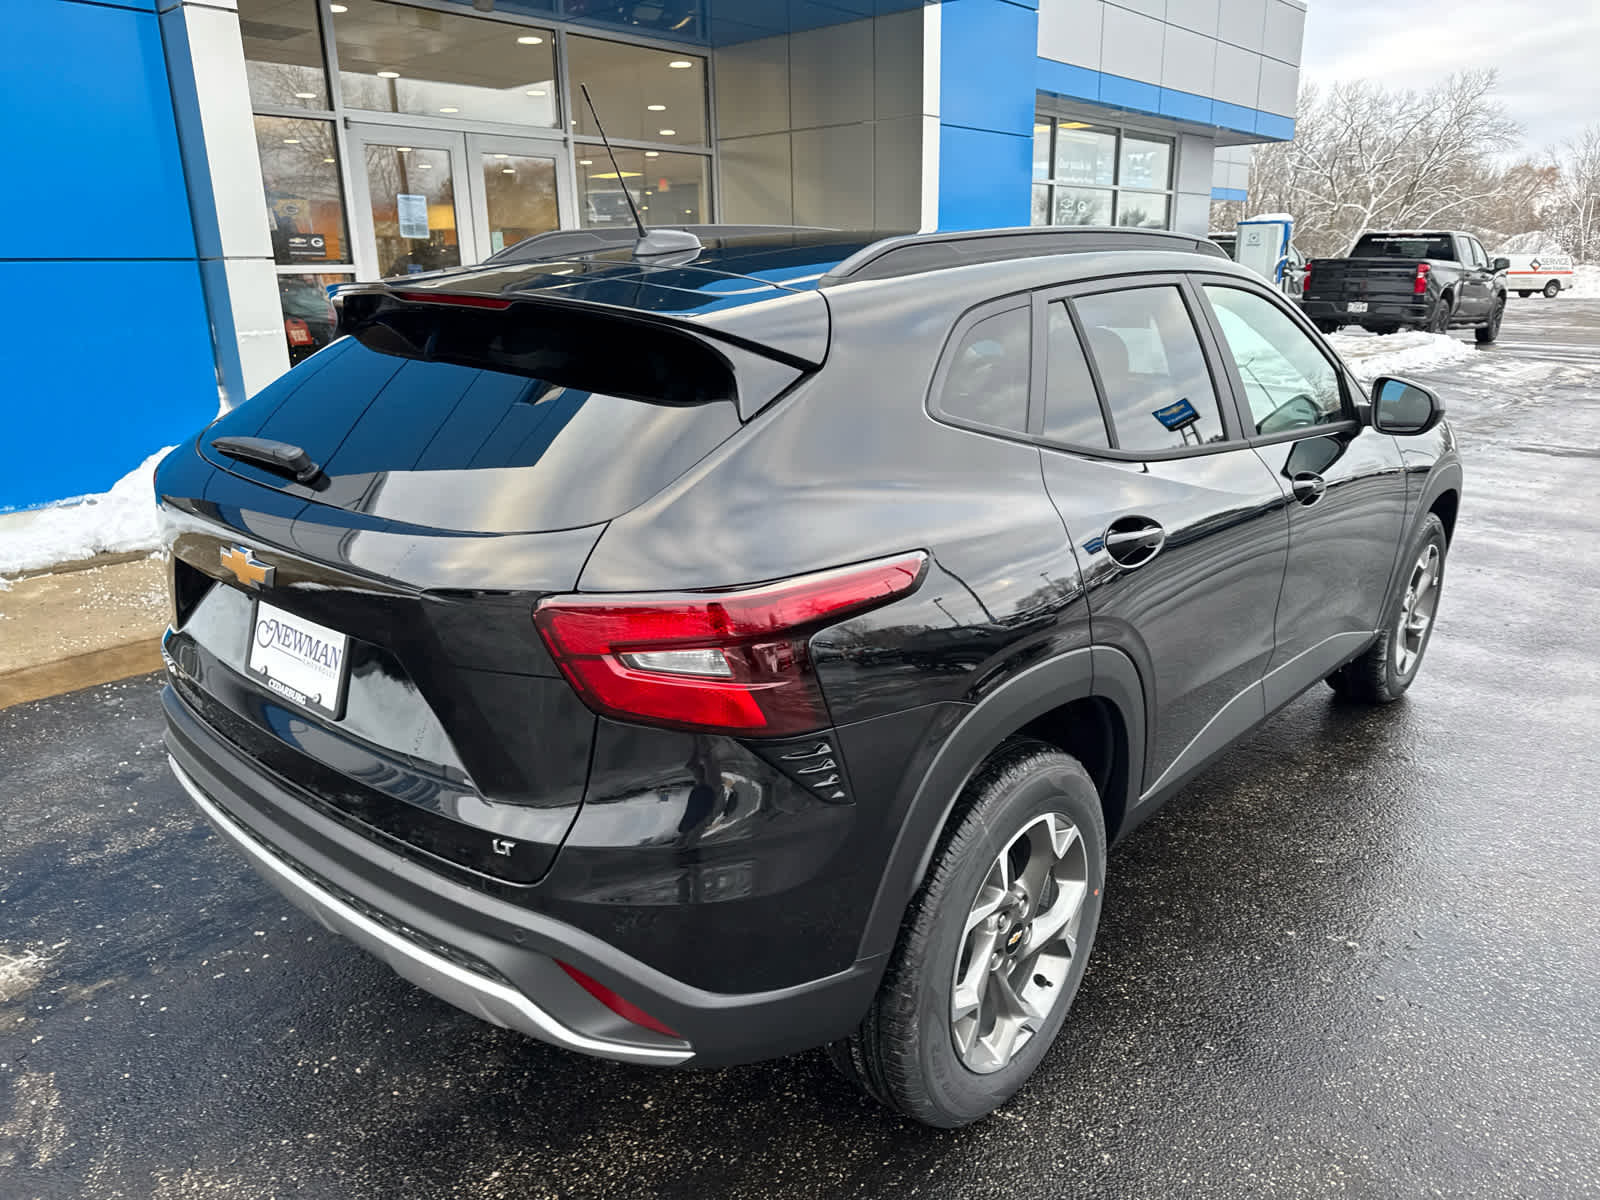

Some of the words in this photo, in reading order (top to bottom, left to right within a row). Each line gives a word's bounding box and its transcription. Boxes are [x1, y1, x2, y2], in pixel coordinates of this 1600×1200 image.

[1541, 257, 1570, 266] SERVICE
[256, 619, 342, 671] NEWMAN
[268, 679, 307, 705] CEDARBURG
[492, 839, 516, 857] LT
